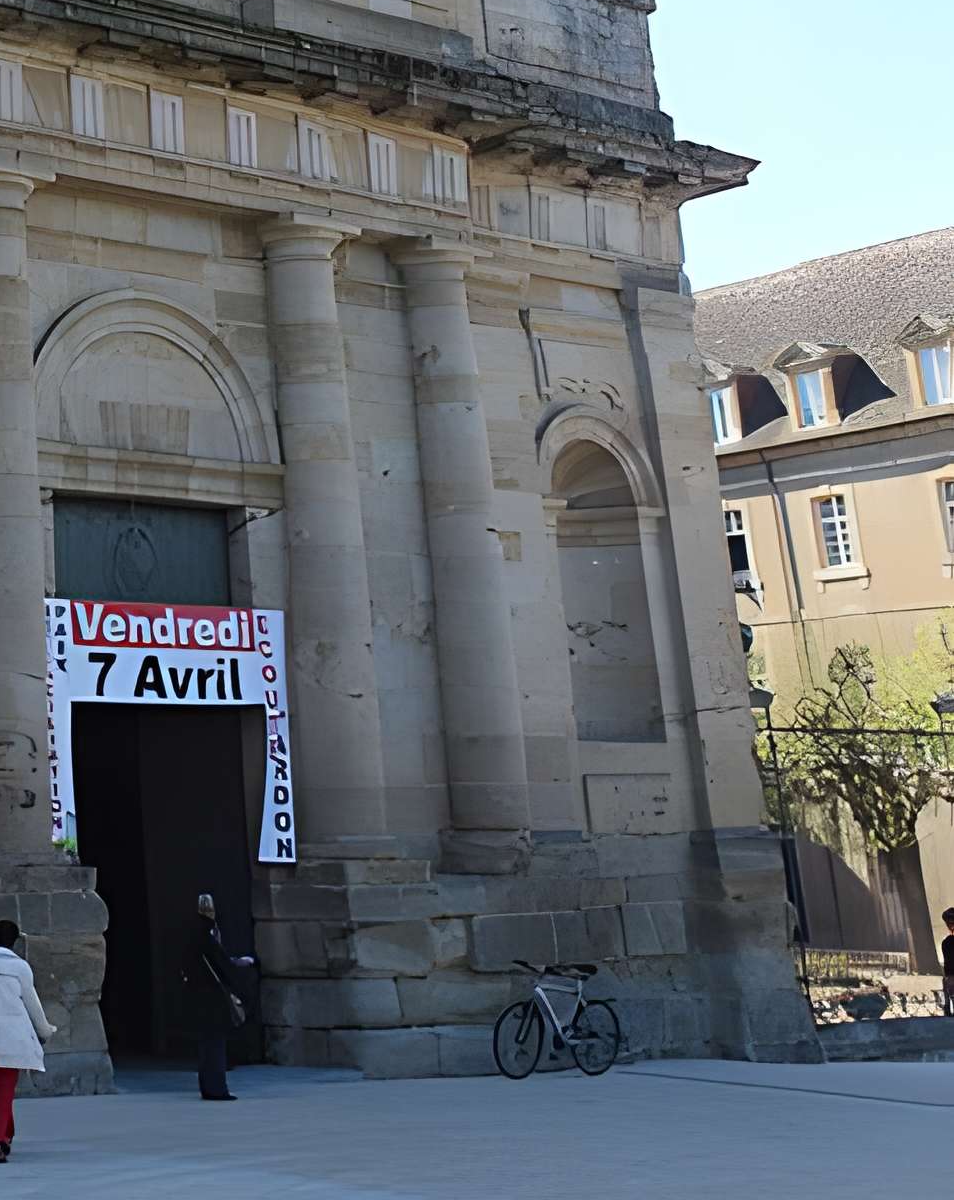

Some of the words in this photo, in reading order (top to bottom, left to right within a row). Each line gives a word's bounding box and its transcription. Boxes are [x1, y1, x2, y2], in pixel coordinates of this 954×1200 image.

[74, 602, 248, 649] Vendredi
[88, 652, 117, 697] 7
[134, 655, 242, 700] Avril
